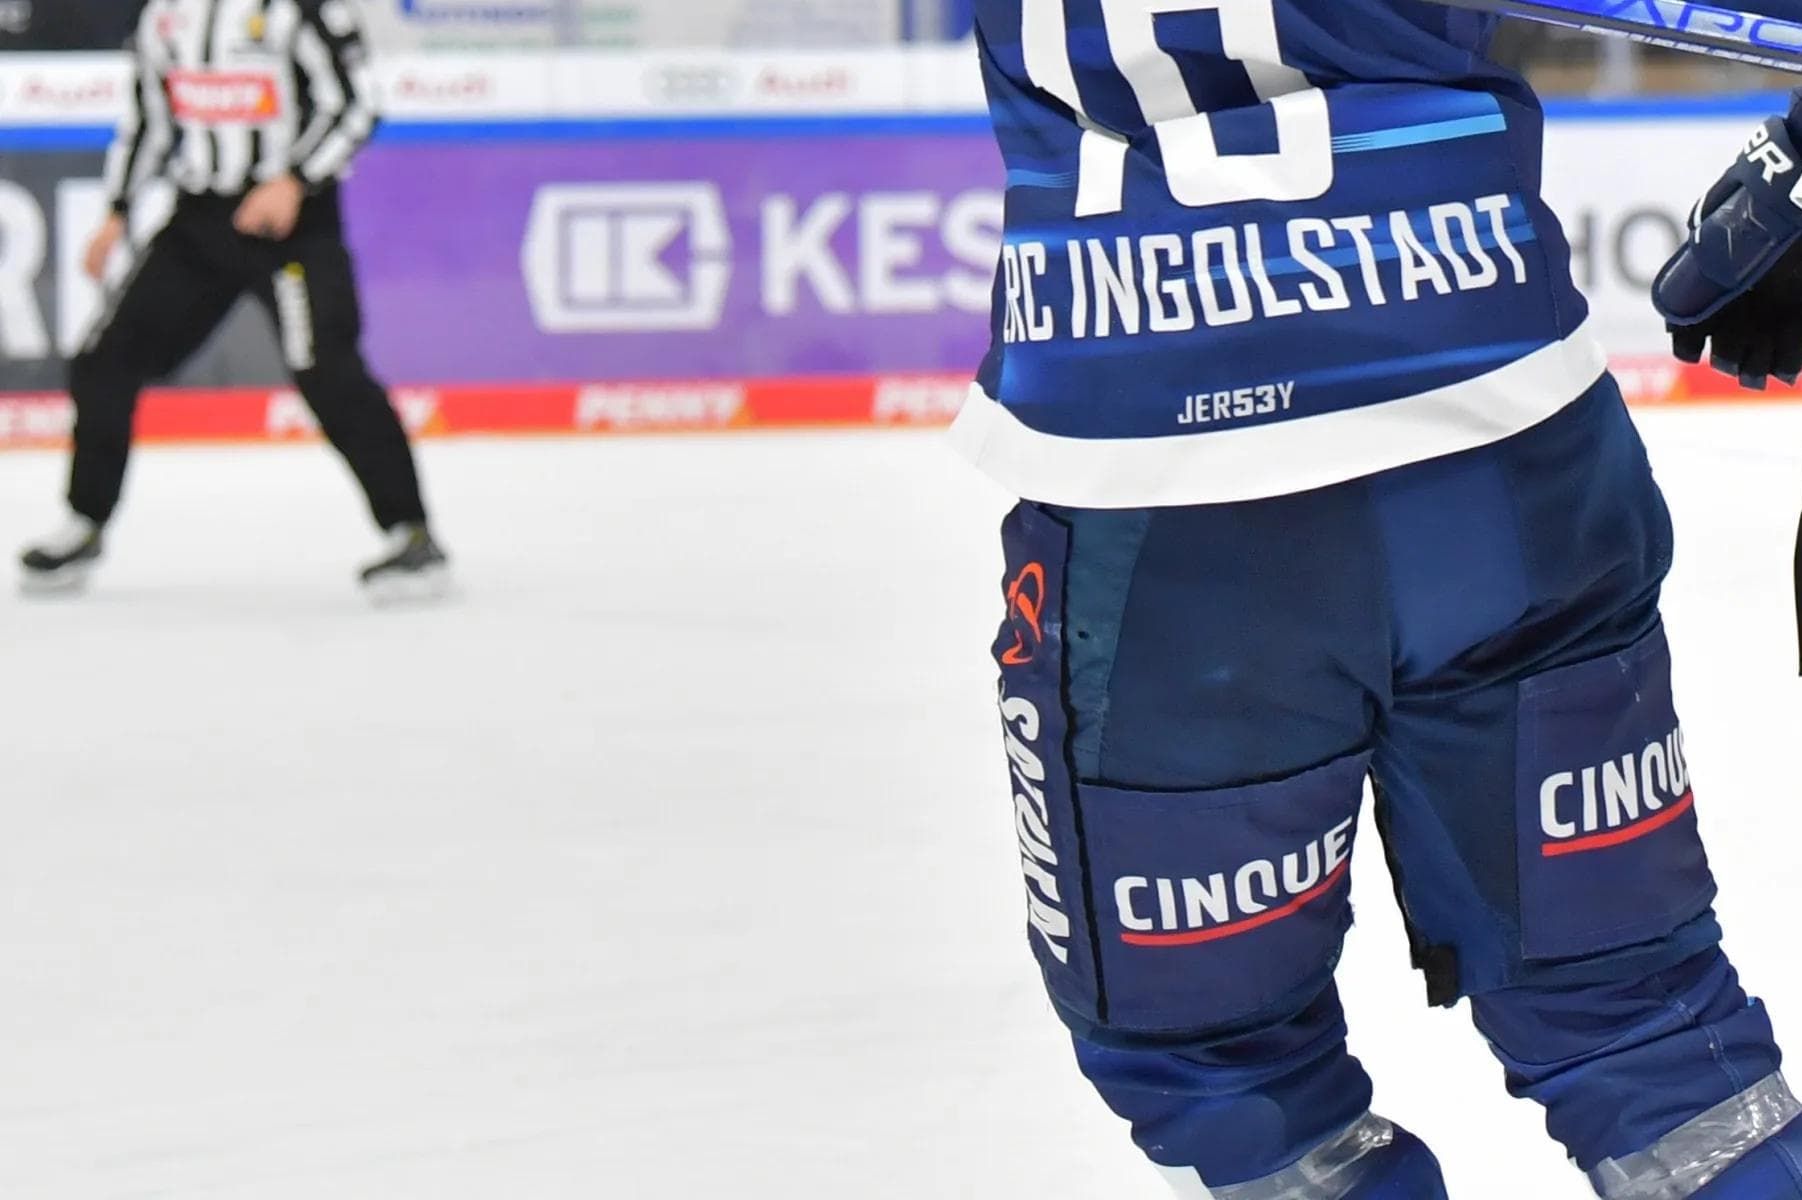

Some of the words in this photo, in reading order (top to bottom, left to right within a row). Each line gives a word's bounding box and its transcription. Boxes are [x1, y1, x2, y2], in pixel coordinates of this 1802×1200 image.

[1003, 242, 1054, 344] RC
[1066, 194, 1528, 340] INGOLSTADT
[1177, 380, 1296, 425] JER53Y
[1540, 724, 1694, 839] CINQU
[1114, 814, 1353, 932] CINQUE
